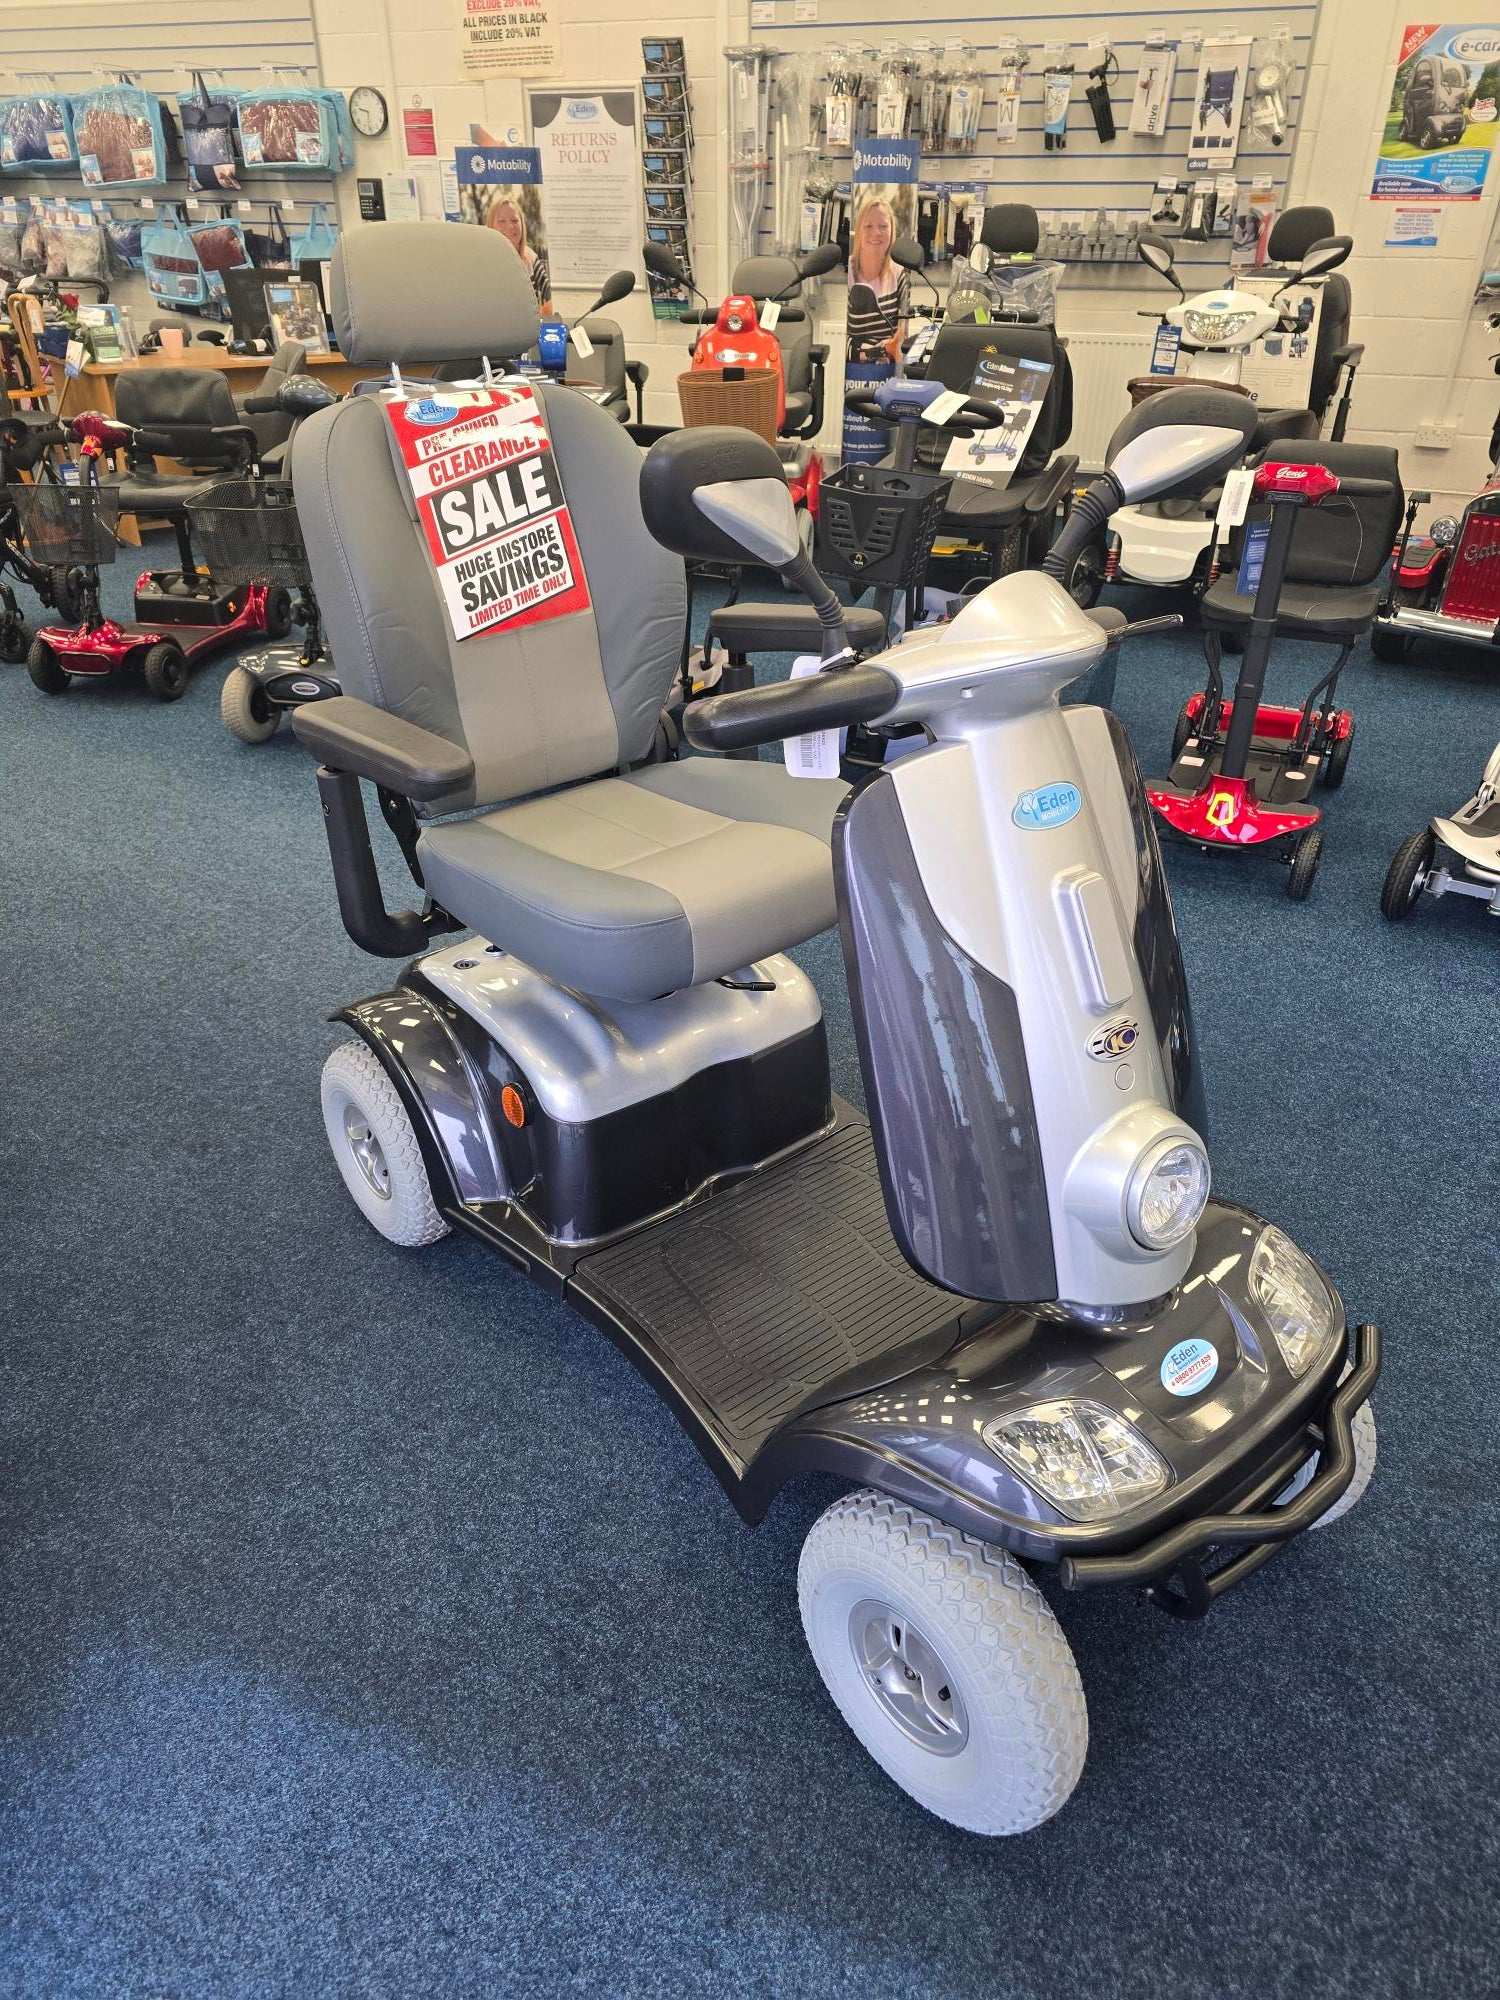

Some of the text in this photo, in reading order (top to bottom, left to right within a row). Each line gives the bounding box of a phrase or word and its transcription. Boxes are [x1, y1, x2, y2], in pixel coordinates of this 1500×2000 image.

[467, 0, 502, 10] EXCLUDE
[463, 12, 548, 28] ALL PRICES IN BLACK
[470, 27, 541, 41] INCLUDE 20% VAT
[1404, 26, 1426, 49] NEW
[1148, 104, 1159, 131] drive
[551, 132, 618, 146] RETURNS
[487, 159, 532, 173] Motability
[559, 150, 611, 164] POLICY
[862, 153, 912, 171] Motability
[428, 436, 536, 487] CLEARANCE
[440, 457, 552, 547] SALE
[455, 524, 556, 583] HUGE INSTORE
[461, 542, 564, 613] SAVINGS
[468, 571, 567, 629] LIMITED TIME ONLY
[1037, 790, 1076, 812] Eden
[1170, 1344, 1198, 1366] Eden
[1174, 1370, 1190, 1384] 0800
